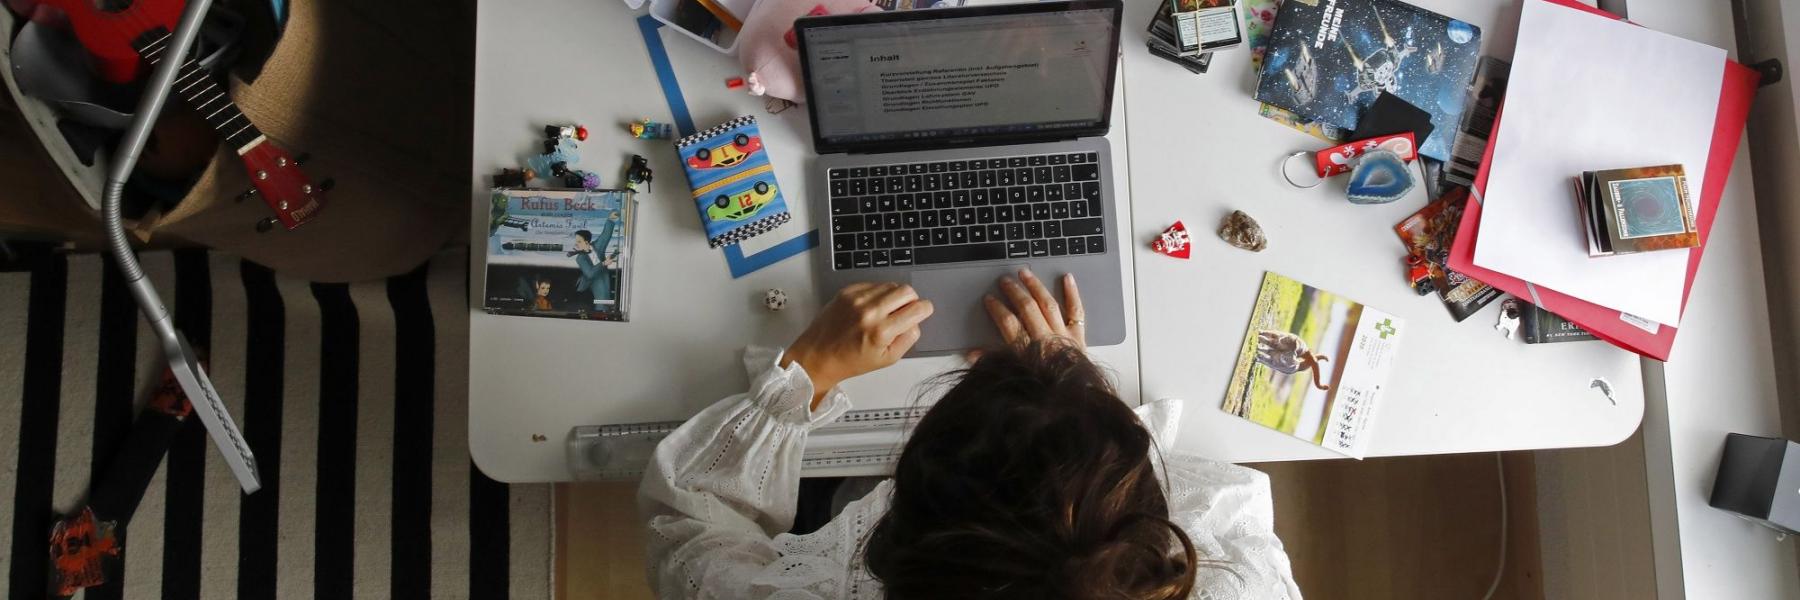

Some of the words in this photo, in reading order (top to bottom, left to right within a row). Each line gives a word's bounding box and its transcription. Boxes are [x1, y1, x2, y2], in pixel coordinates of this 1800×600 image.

[1314, 0, 1336, 49] FREUNDE
[1328, 8, 1344, 42] MEINE
[869, 54, 900, 62] Inhalt
[521, 196, 559, 211] Rufus
[564, 197, 595, 211] Beck
